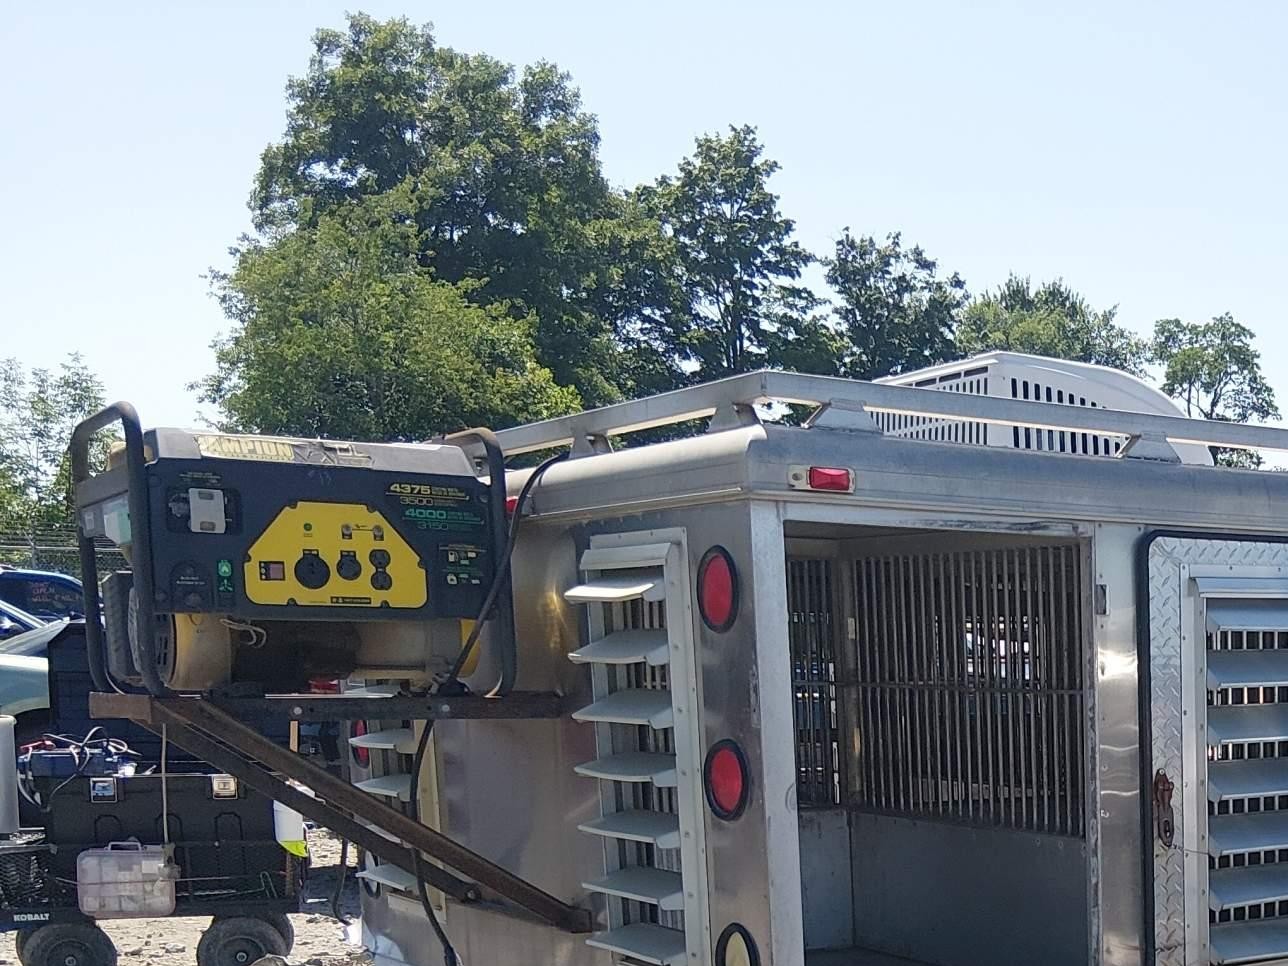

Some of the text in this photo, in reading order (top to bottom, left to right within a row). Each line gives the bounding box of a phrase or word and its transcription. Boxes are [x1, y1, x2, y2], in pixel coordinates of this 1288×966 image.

[202, 435, 293, 457] AMPION
[390, 483, 431, 495] 4375
[400, 496, 433, 506] 3500
[405, 508, 447, 519] 4000
[13, 913, 50, 922] KOBALT
